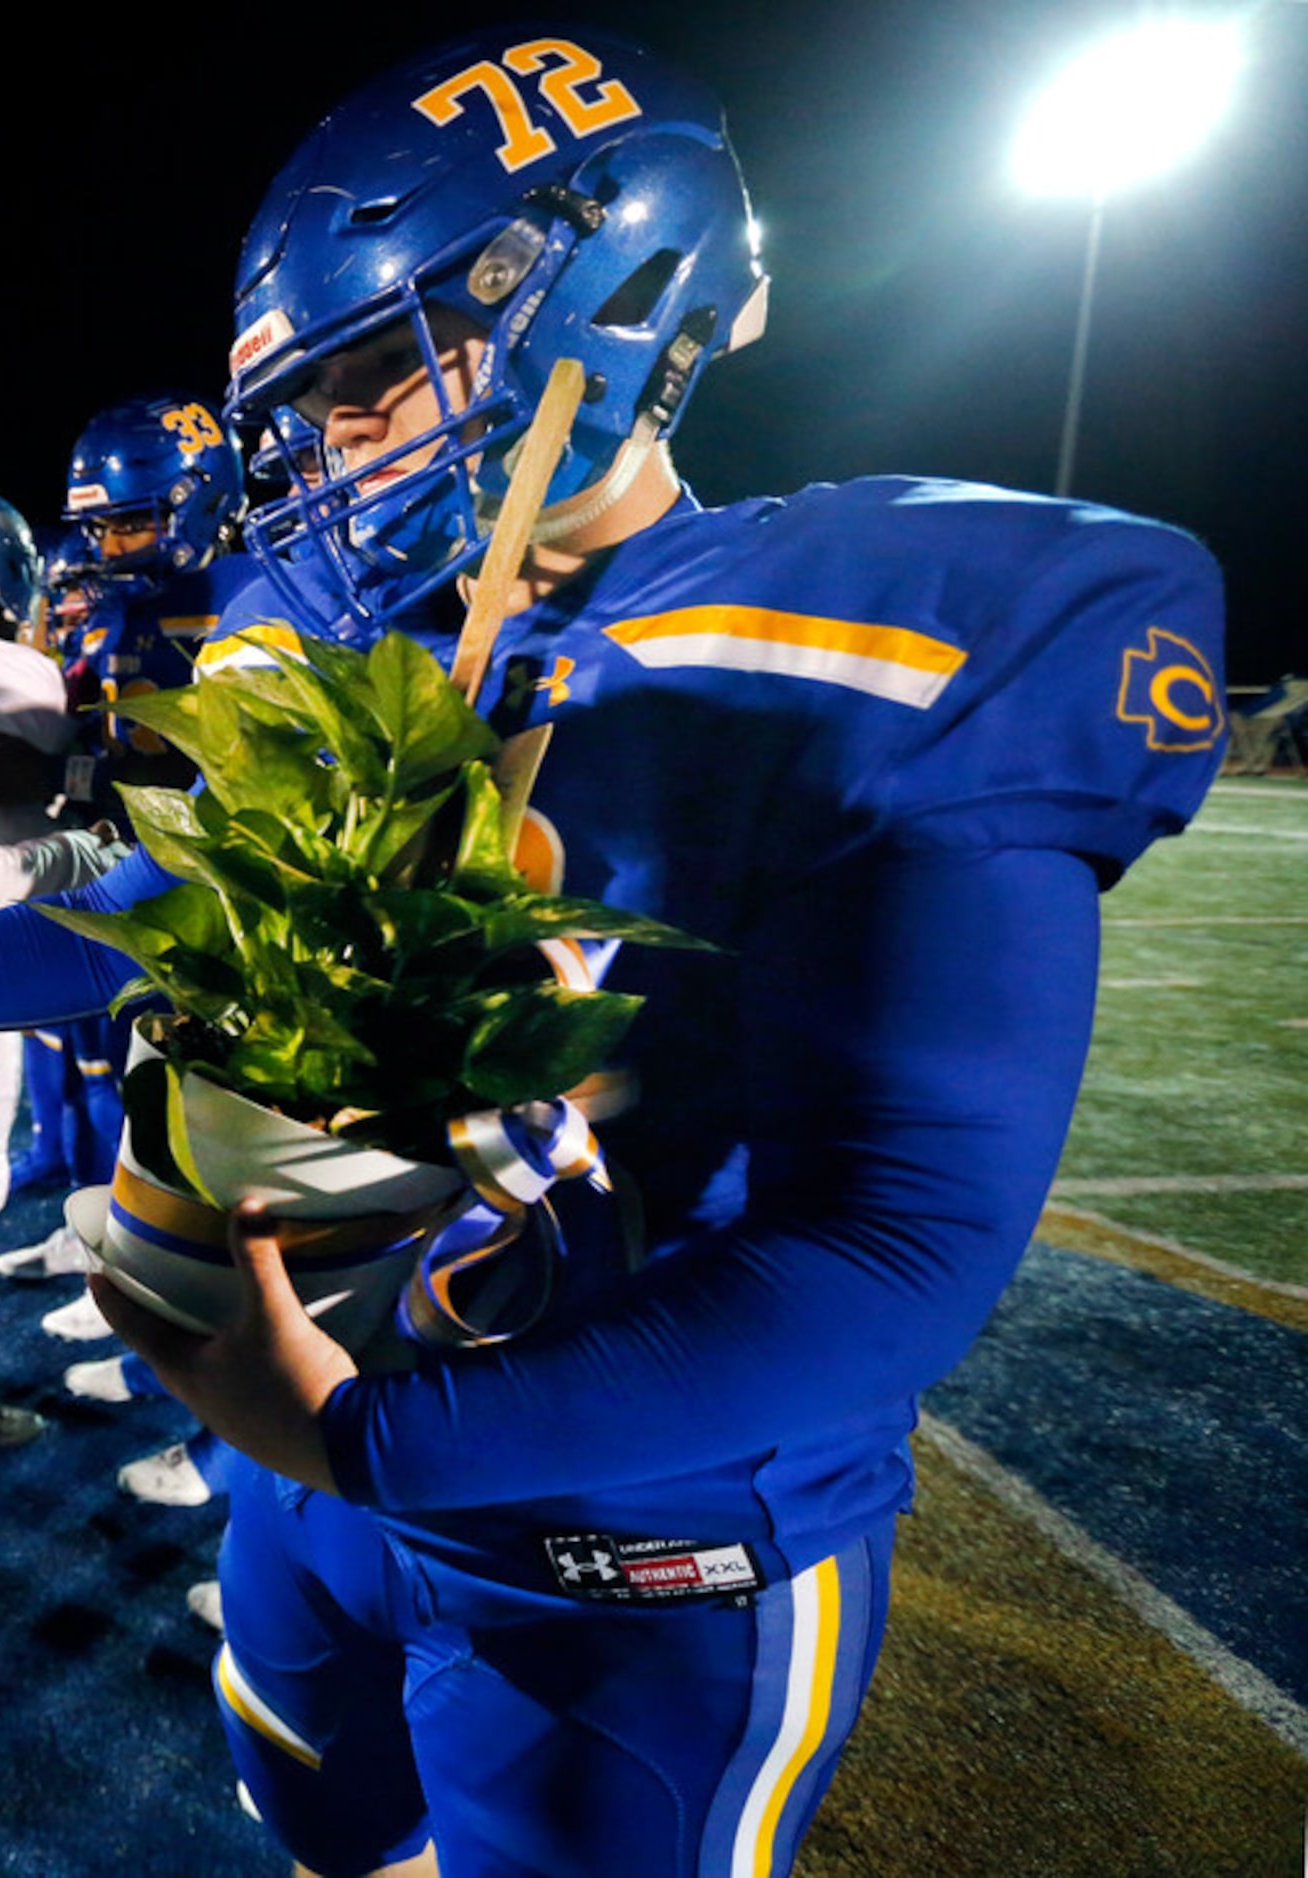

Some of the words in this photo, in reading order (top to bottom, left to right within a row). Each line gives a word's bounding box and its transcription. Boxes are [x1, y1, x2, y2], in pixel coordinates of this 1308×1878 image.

[410, 37, 642, 174] 72
[161, 402, 224, 455] 33
[1150, 664, 1212, 731] C
[629, 1564, 697, 1583] AUTHENTIC
[704, 1562, 747, 1576] XXL
